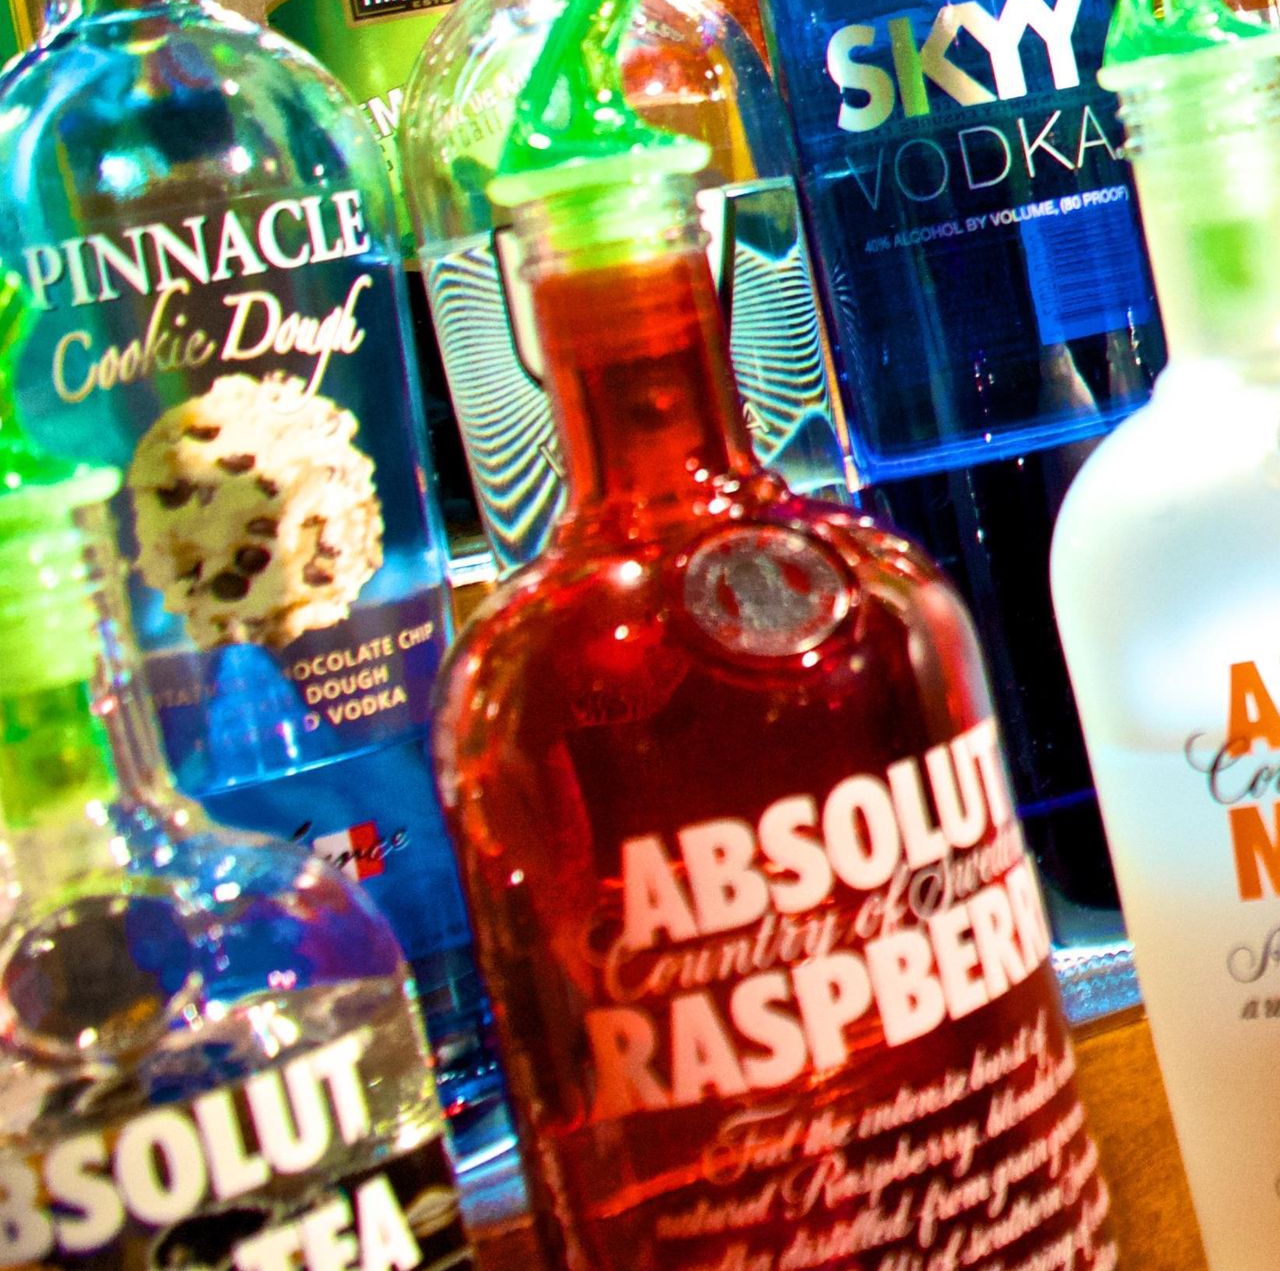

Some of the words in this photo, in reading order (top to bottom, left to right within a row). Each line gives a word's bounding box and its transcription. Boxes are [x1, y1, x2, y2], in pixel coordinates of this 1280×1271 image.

[845, 104, 1119, 212] VODKA
[22, 187, 372, 311] PINNACLE
[894, 226, 964, 248] ALCOHOL
[965, 215, 987, 233] BY
[989, 200, 1059, 228] VOLUME,
[1082, 184, 1129, 209] PROOF)
[52, 270, 217, 404] Cookie
[219, 273, 374, 395] Dough
[398, 621, 435, 651] CHIP
[305, 666, 389, 706] DOUGH
[327, 685, 407, 727] VODKA
[622, 716, 1013, 951] ABSOLUT
[589, 909, 842, 1002] Country
[1240, 1001, 1259, 1020] a
[0, 1028, 376, 1266] BSOLUT
[780, 1120, 980, 1220] Raspberry
[232, 1174, 424, 1271] TEA
[918, 1174, 990, 1249] from
